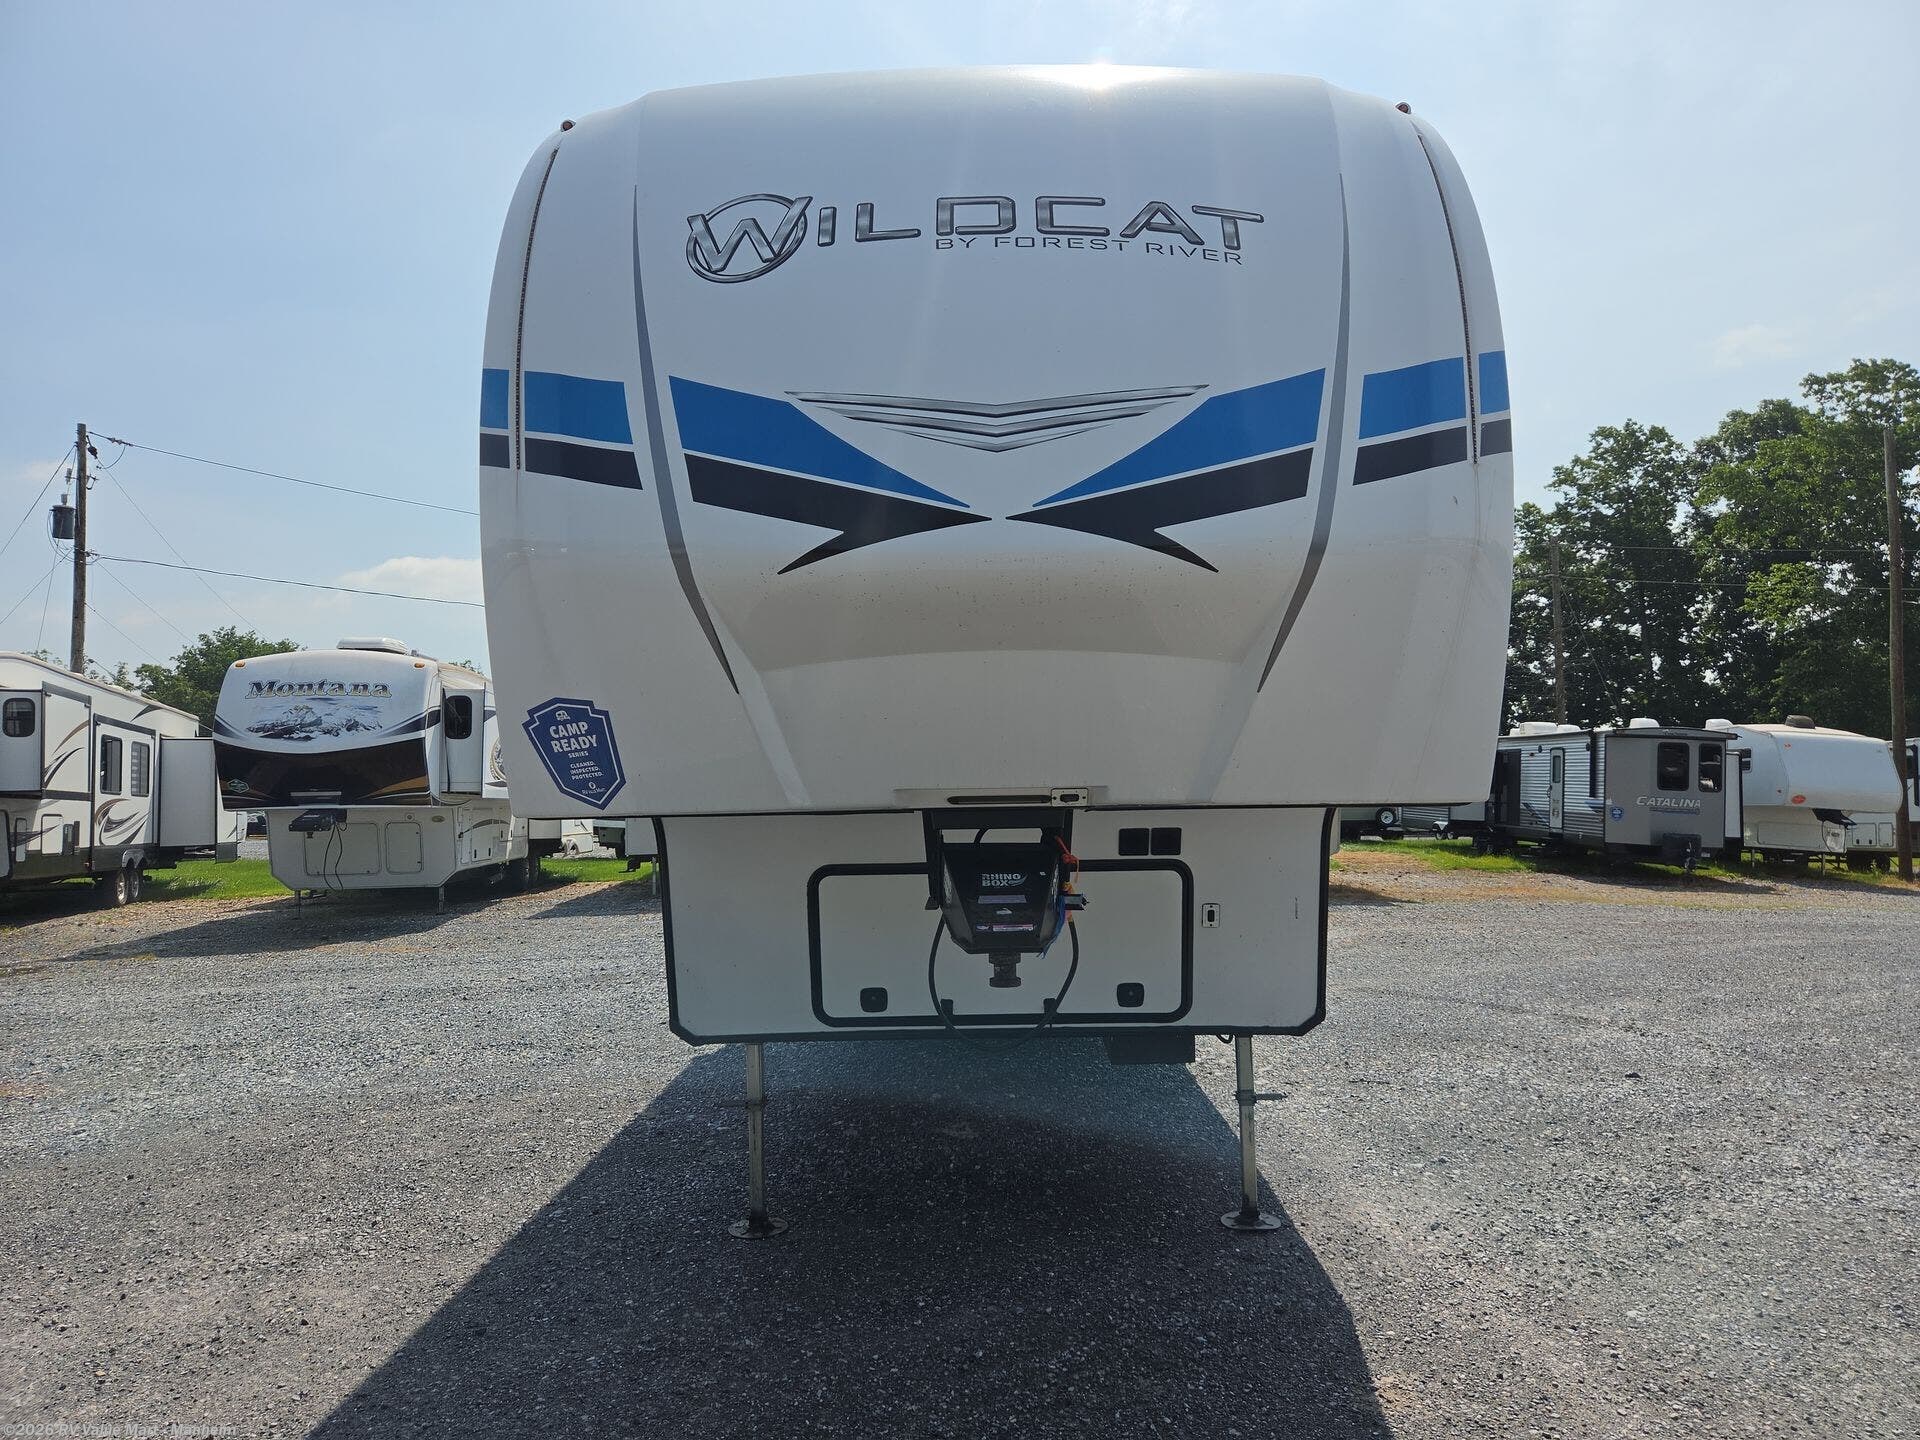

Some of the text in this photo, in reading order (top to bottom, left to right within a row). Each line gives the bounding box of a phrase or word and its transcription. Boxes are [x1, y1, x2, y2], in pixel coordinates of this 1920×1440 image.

[687, 194, 1264, 283] WILDCAT
[935, 236, 1243, 265] BY FOREST RIVER
[245, 679, 392, 699] Montana
[549, 722, 588, 738] CAMP
[550, 735, 597, 753] READY
[1636, 796, 1701, 809] CATALINA
